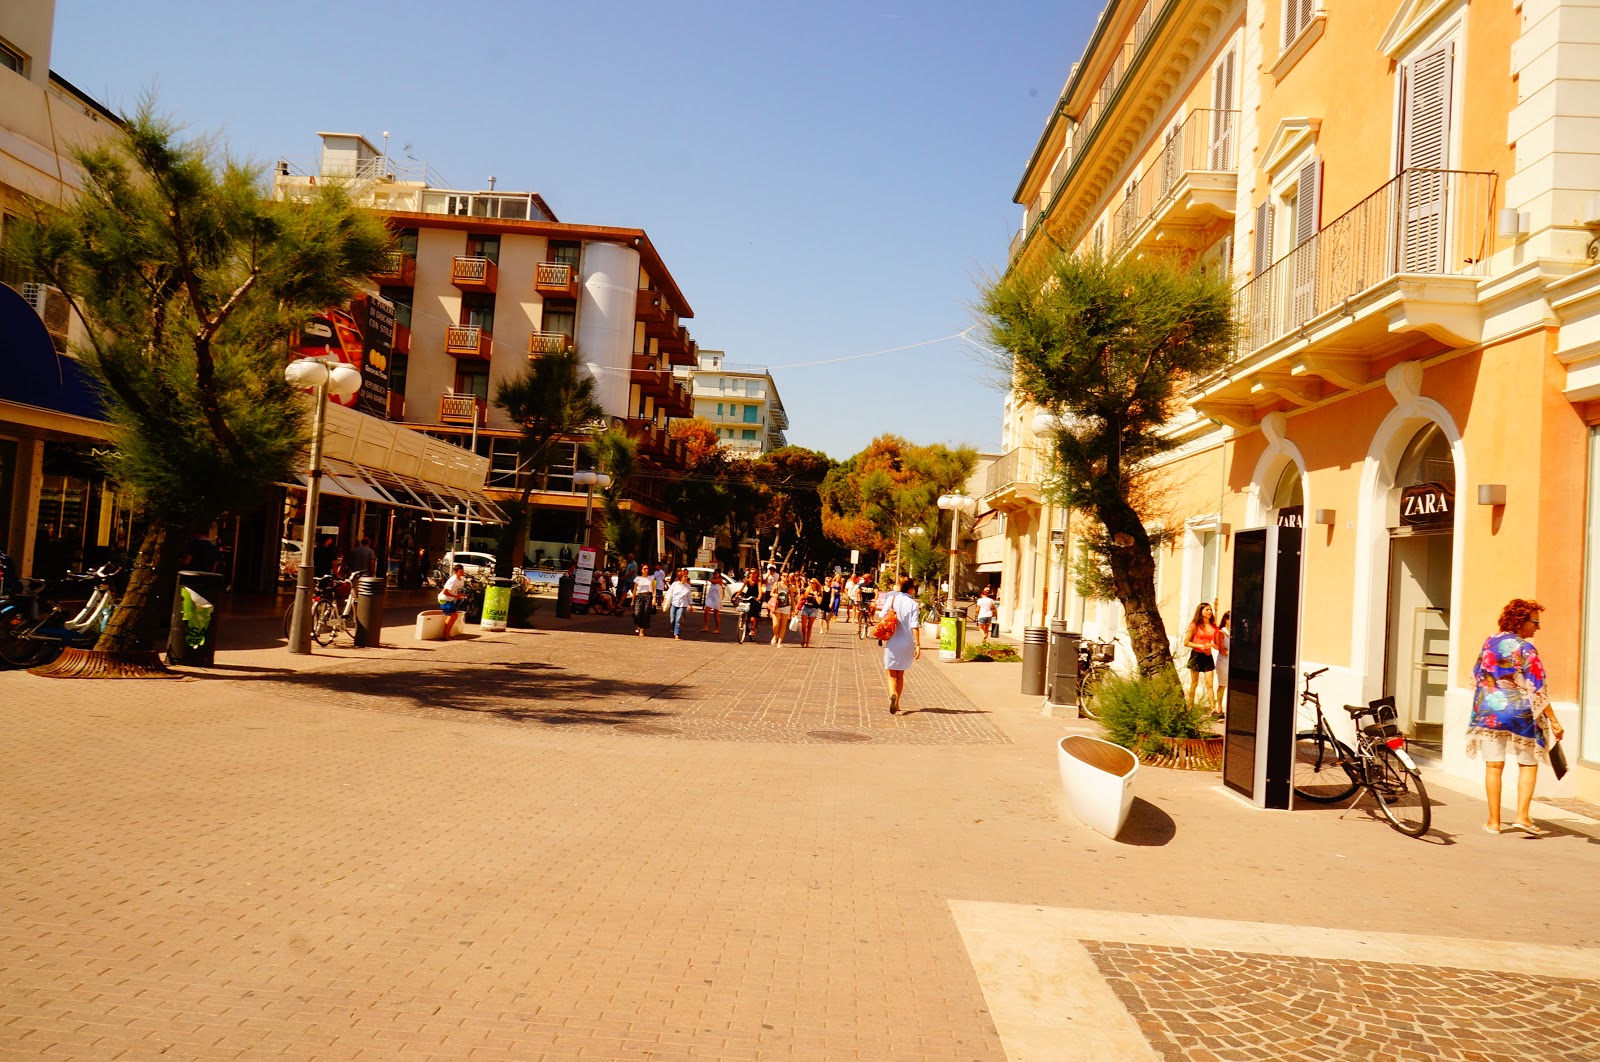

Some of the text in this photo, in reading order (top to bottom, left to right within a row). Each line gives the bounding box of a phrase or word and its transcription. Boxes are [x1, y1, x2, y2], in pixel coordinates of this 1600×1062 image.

[368, 318, 379, 330] CON
[1403, 491, 1448, 517] ZARA
[1277, 514, 1303, 528] ZARA
